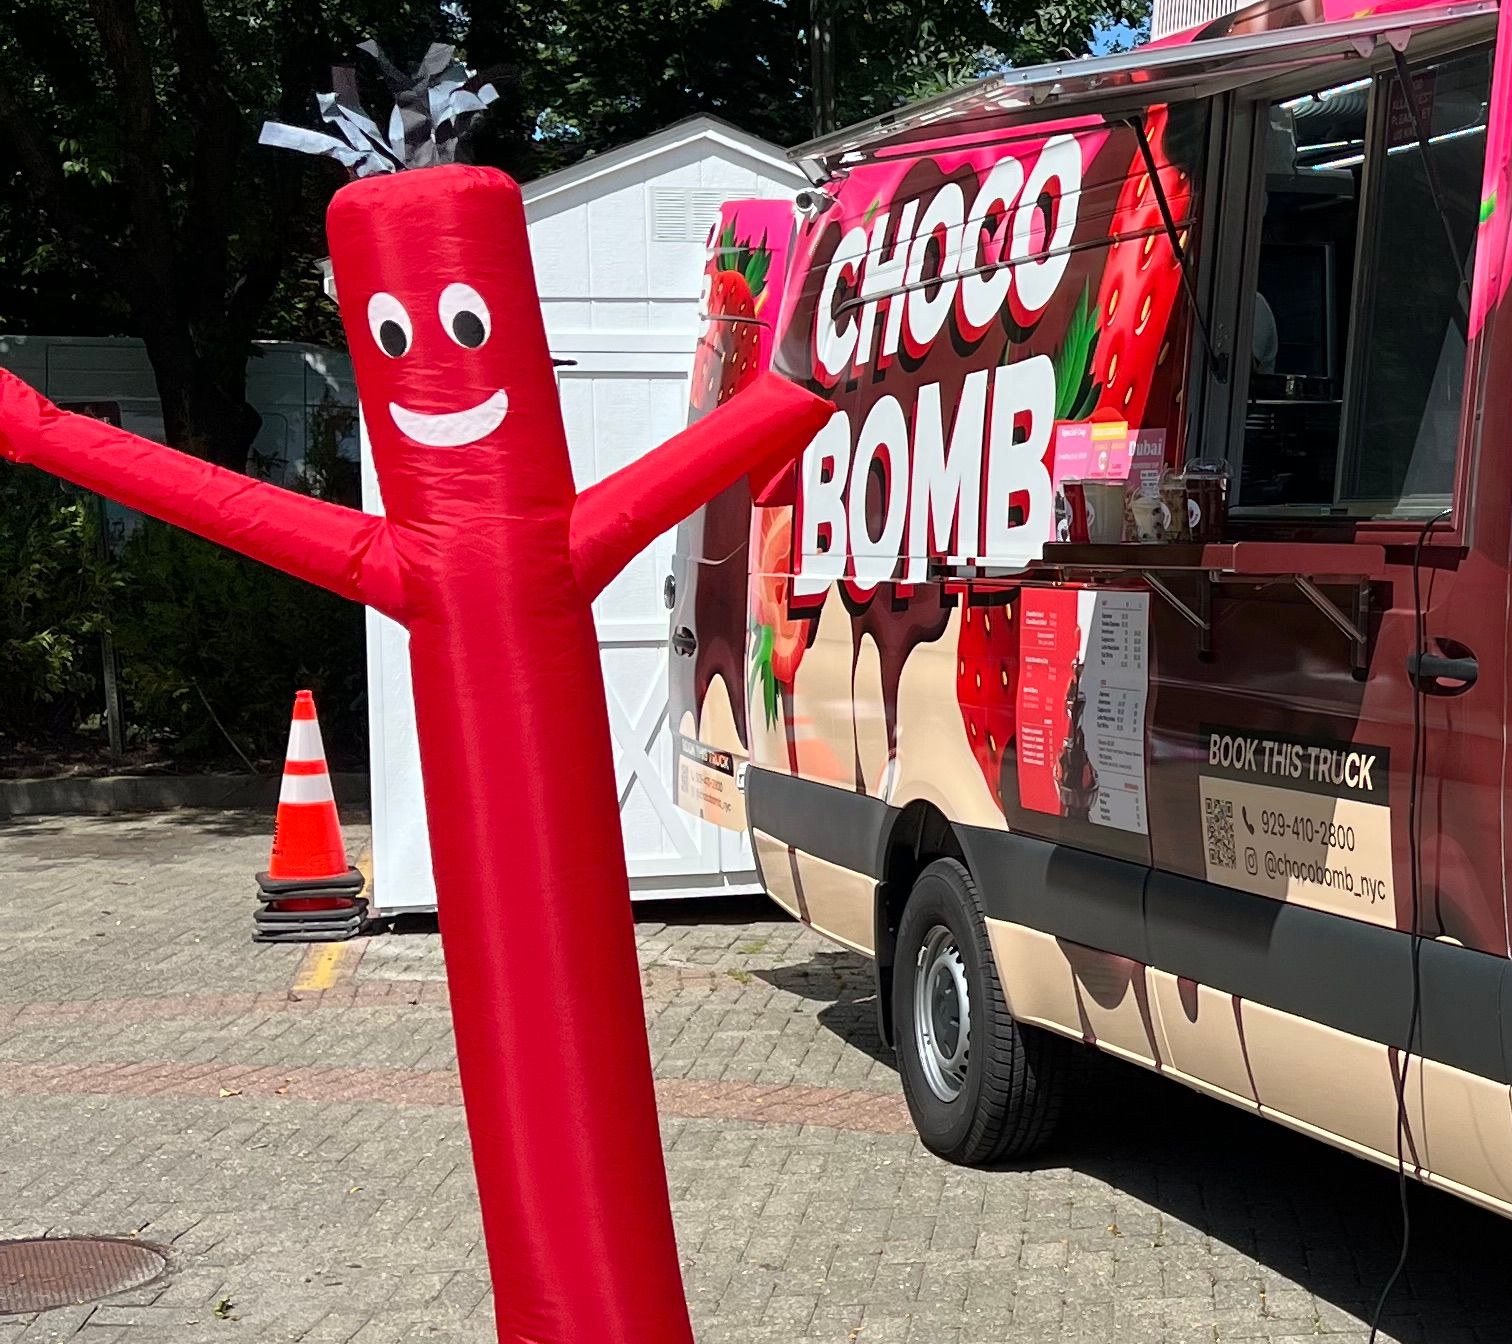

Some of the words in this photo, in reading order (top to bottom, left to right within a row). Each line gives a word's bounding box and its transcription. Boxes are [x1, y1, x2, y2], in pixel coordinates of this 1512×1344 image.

[816, 133, 1083, 377] CHOCO
[793, 354, 1057, 597] BOMB
[1128, 438, 1163, 457] Dubai
[1208, 733, 1259, 772] BOOK
[1262, 740, 1303, 778] THIS
[1307, 746, 1377, 791] TRUCK
[1261, 809, 1355, 852] 929-410-2800
[1264, 850, 1386, 904] @chocobomb_nyc
